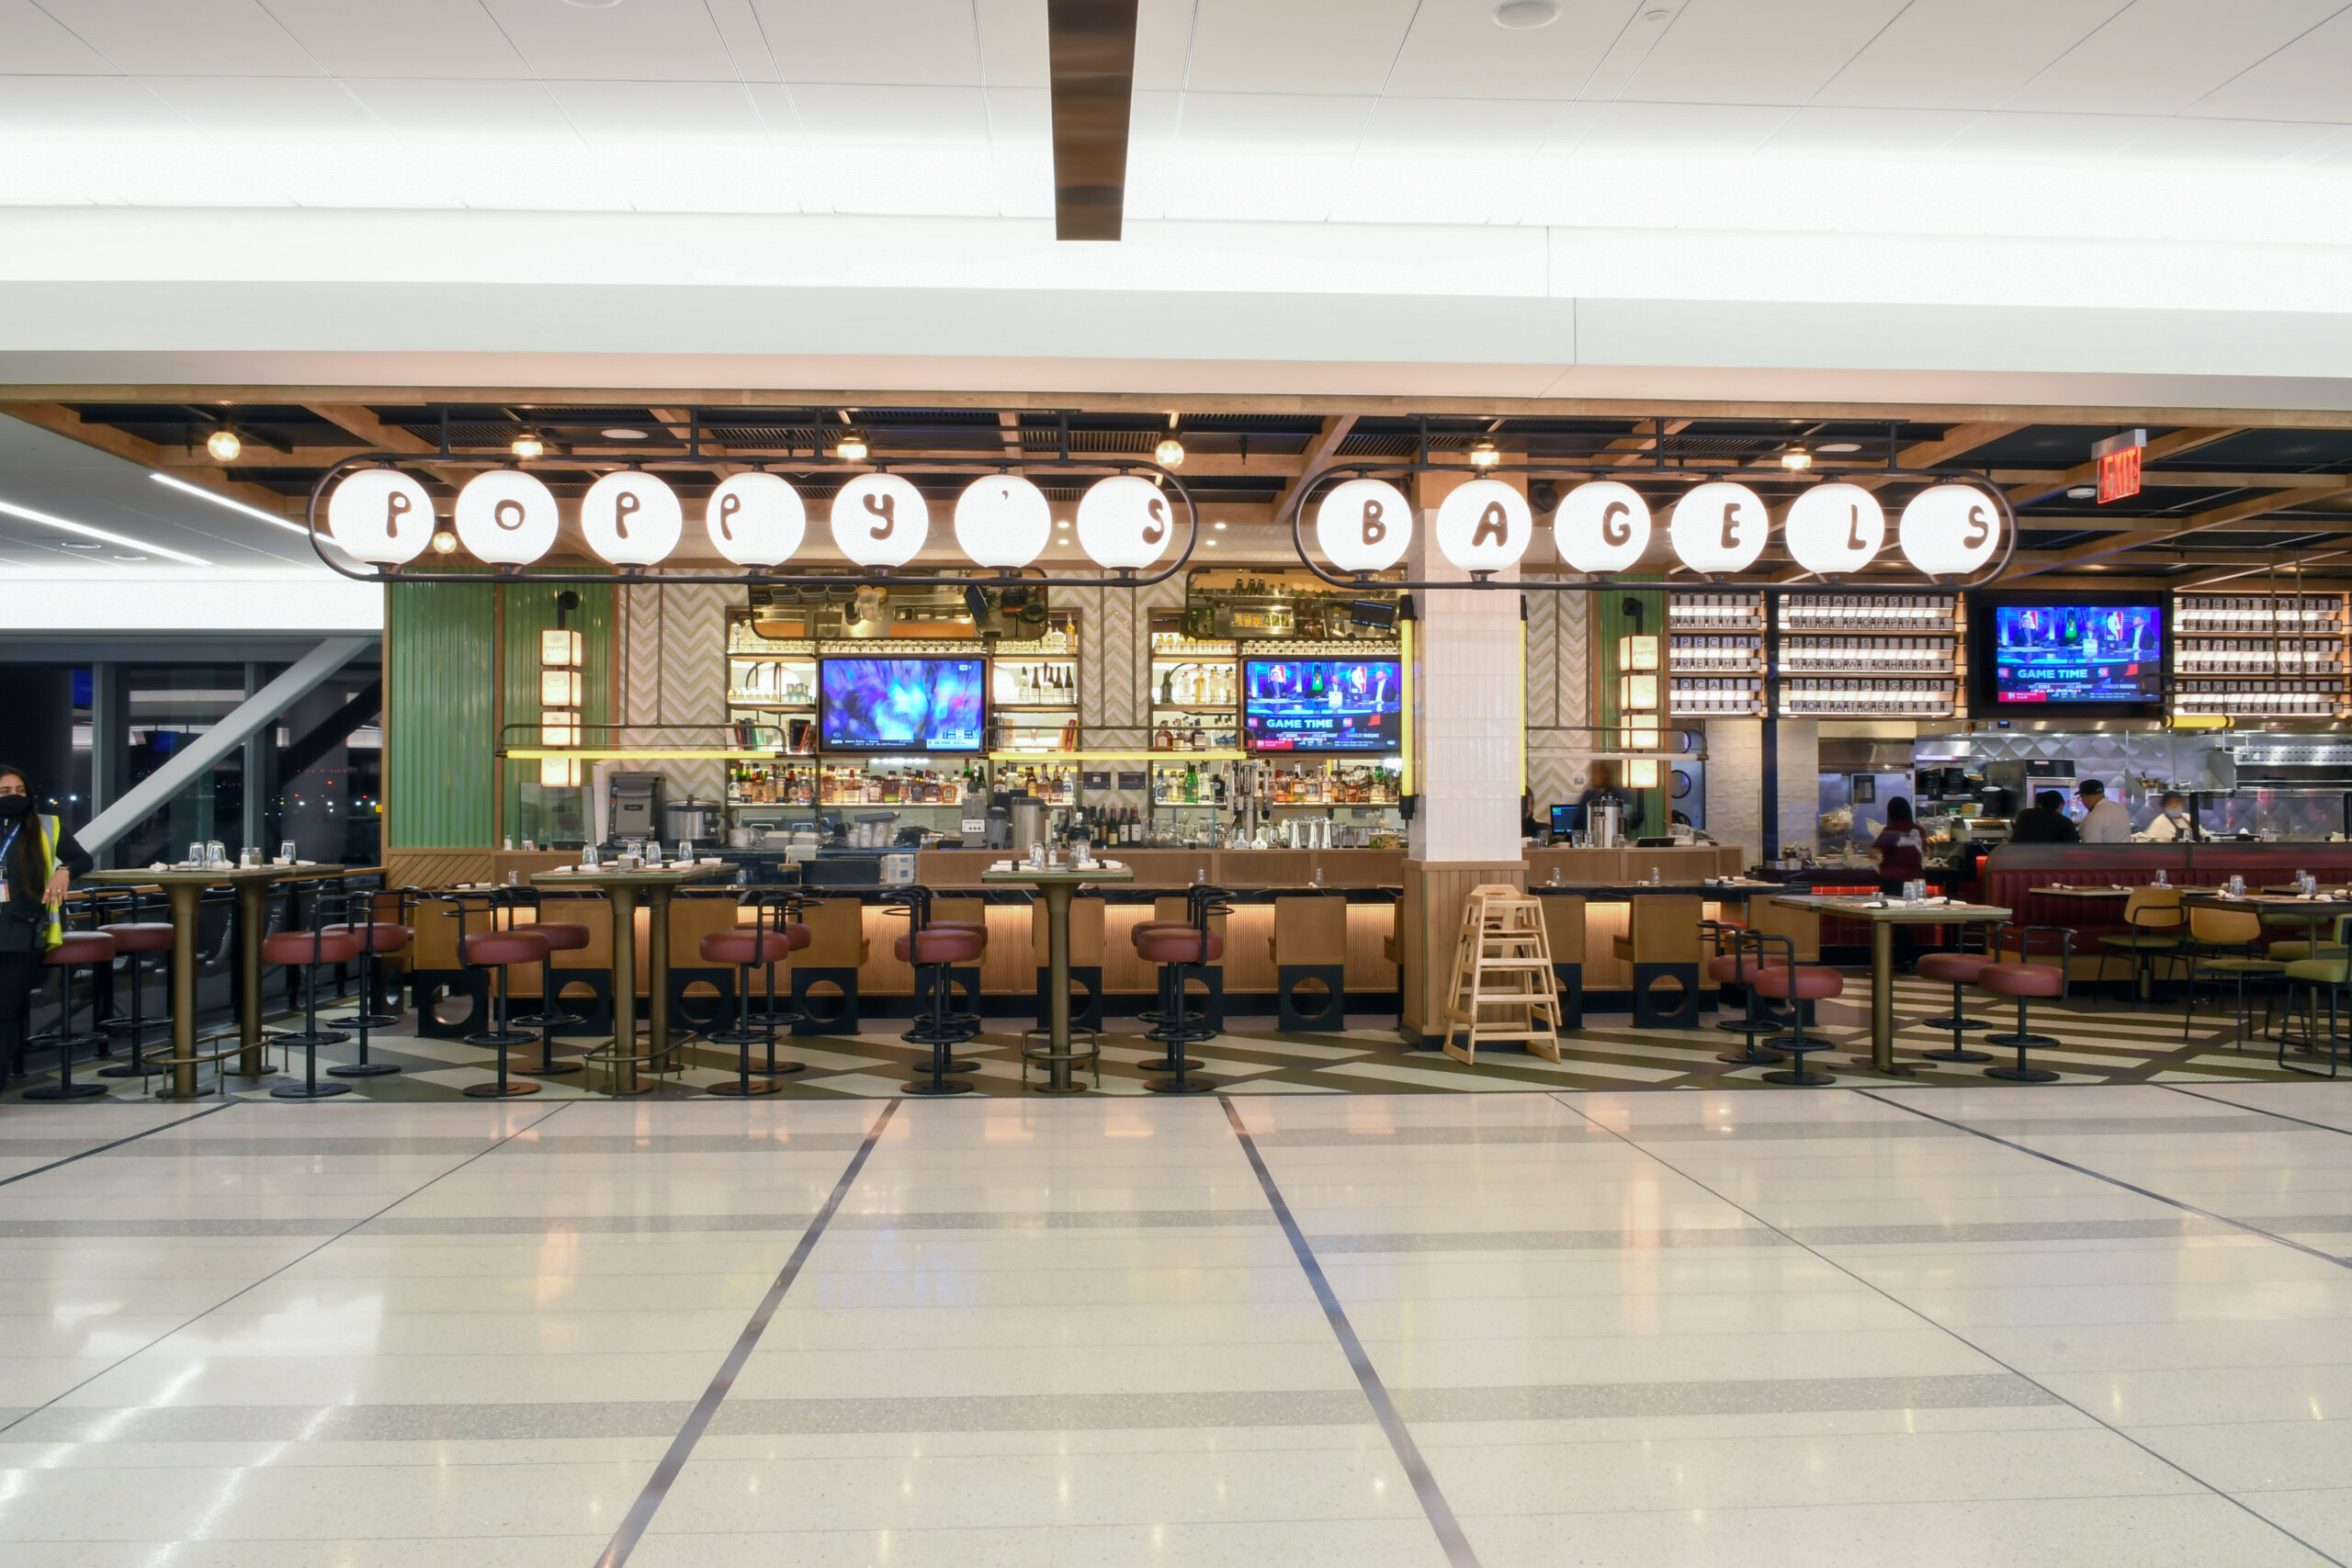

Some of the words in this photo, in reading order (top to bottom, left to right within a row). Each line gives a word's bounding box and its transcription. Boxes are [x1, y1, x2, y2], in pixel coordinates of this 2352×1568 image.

[2103, 448, 2137, 501] EXIT
[387, 490, 1164, 546] POPPY'S
[1362, 498, 1990, 551] BAGELS
[1793, 597, 1911, 605] BREAKFAST
[2188, 599, 2247, 608] FRESH
[1793, 618, 1829, 626] BIG
[1849, 618, 1911, 626] POPPY
[2188, 621, 2248, 629] PLAIN
[1670, 637, 1758, 648] SPECIAL
[1793, 638, 1870, 648] BAGELS
[1794, 660, 1925, 669] SANDWICHES
[2018, 669, 2055, 679] GAME
[2057, 669, 2088, 678] TIME
[1670, 680, 1730, 690] OCAL
[1793, 680, 1939, 690] BACON&EGGS&
[2188, 682, 2248, 691] BAGEL
[1793, 702, 1898, 711] POTATOES
[2188, 704, 2276, 713] SPREADS
[1266, 719, 1302, 728] GAME
[1304, 719, 1333, 728] TIME
